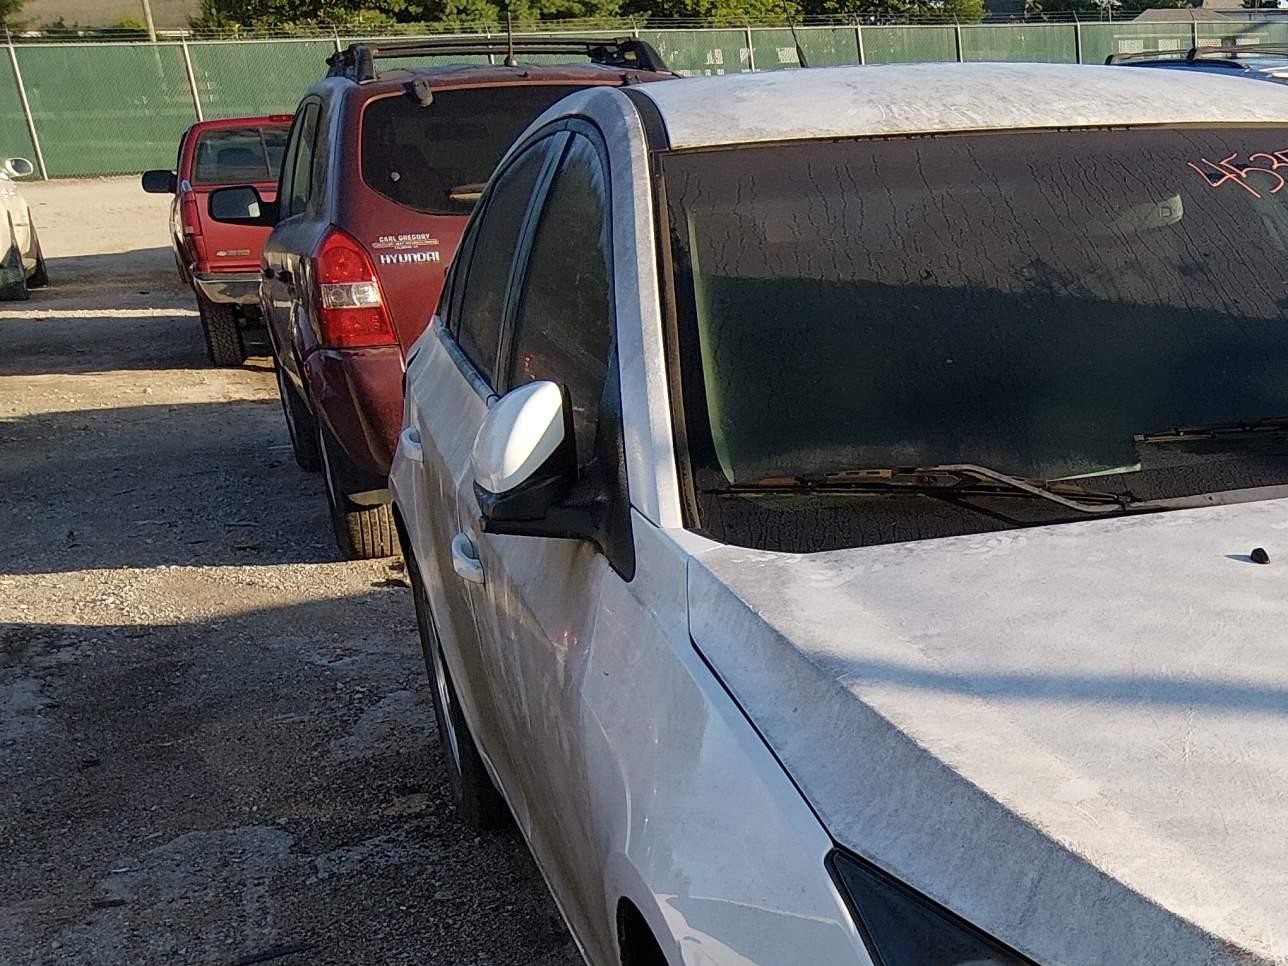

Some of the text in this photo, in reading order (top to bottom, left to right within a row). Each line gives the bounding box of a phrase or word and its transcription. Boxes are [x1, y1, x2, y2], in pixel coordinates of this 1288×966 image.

[378, 233, 430, 243] CARL GREGORY
[380, 251, 440, 264] HYUNDAI
